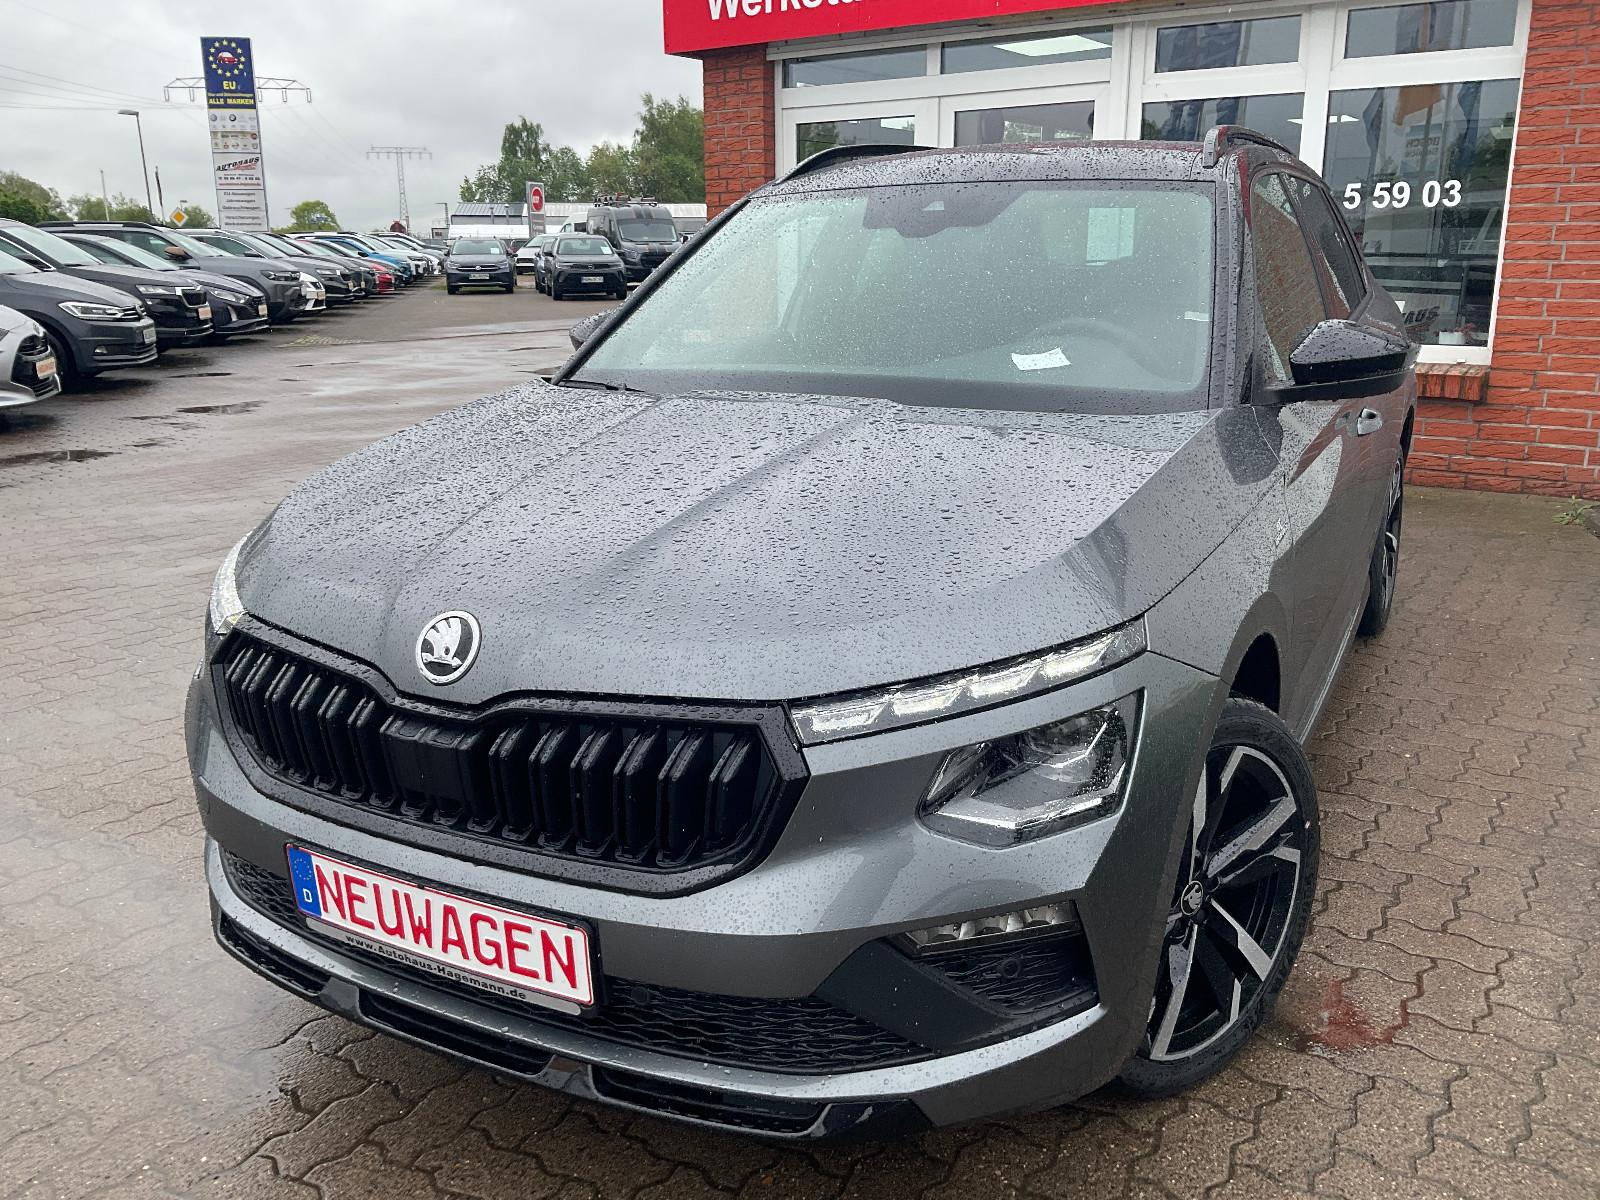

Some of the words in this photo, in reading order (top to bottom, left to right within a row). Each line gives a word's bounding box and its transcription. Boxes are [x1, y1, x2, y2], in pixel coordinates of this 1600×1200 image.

[223, 81, 236, 90] EU
[215, 157, 260, 171] AUTOHAUS
[1342, 183, 1362, 210] 5
[1372, 181, 1411, 209] 59
[1422, 179, 1463, 208] 03
[302, 888, 313, 903] D
[315, 863, 578, 989] NEUWAGEN
[345, 934, 527, 1000] www.Autohaus-Hagemann.de
